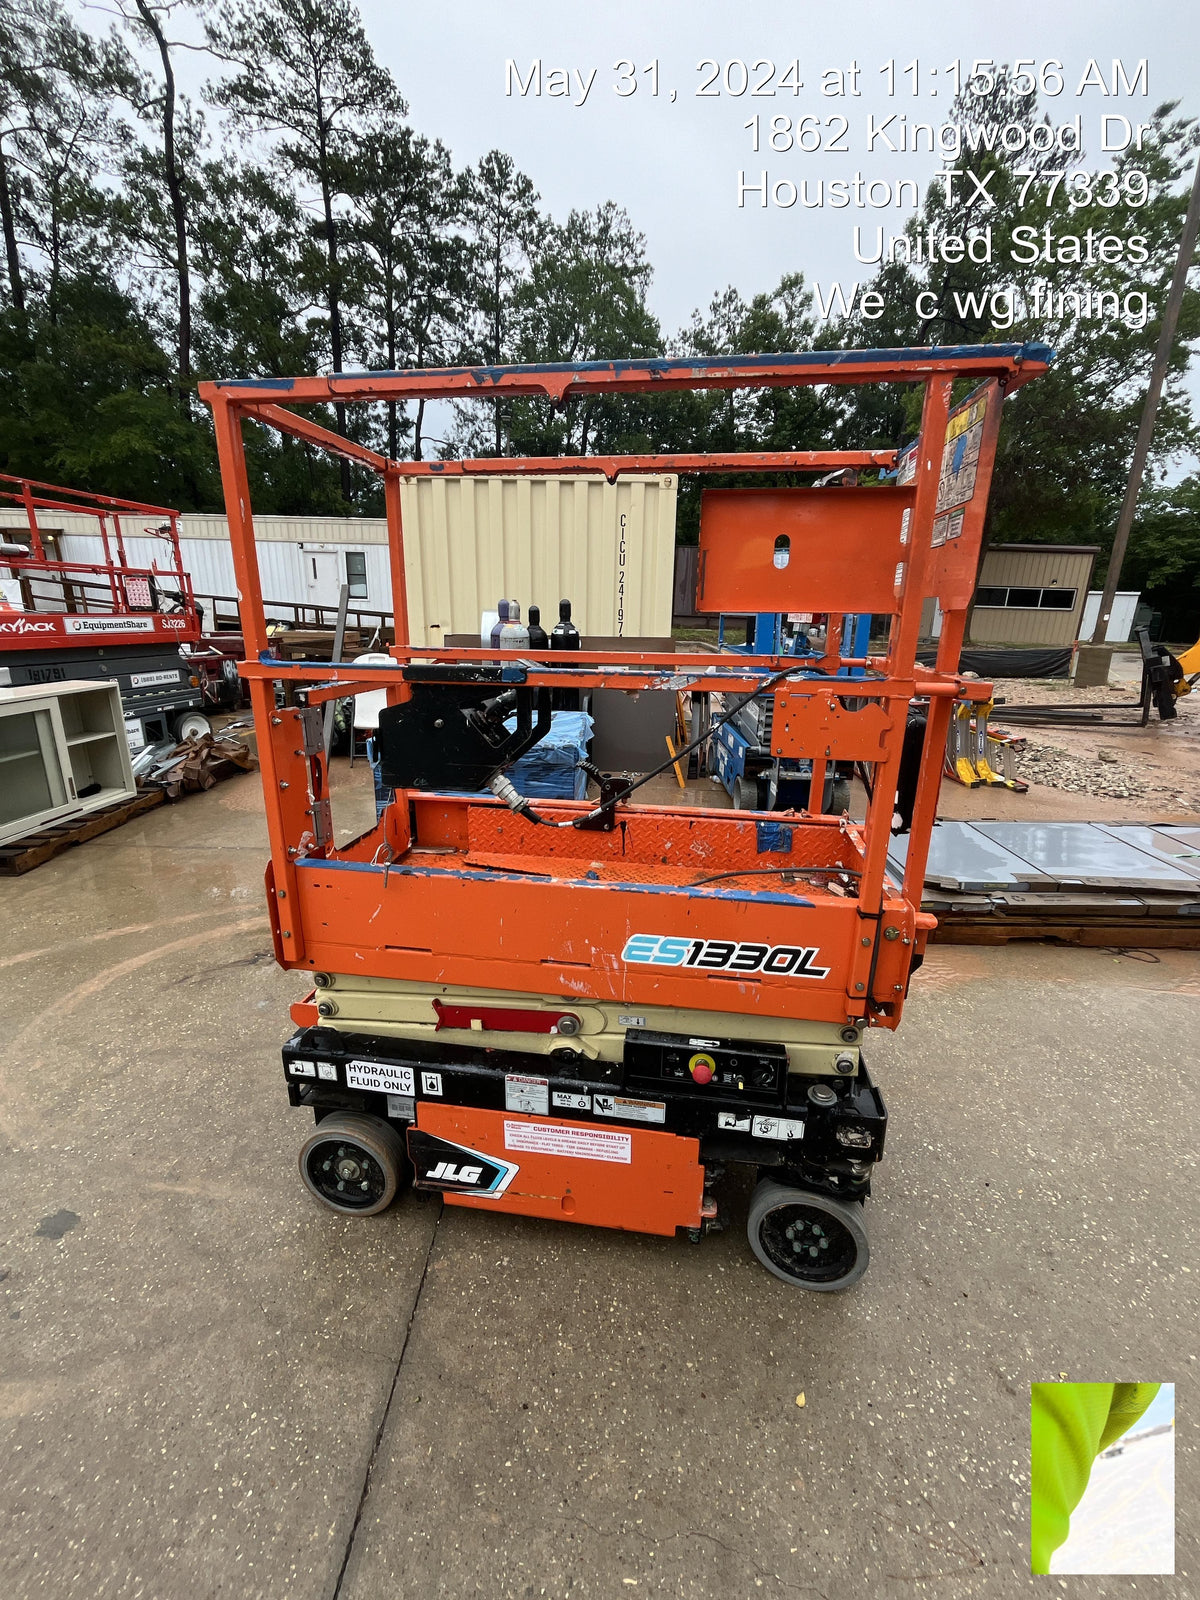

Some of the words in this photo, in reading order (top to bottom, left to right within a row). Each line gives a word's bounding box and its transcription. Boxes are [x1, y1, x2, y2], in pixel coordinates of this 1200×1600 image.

[619, 514, 627, 567] CICU
[0, 617, 57, 634] KYJACK
[82, 620, 148, 631] EquipmentShare
[621, 934, 831, 980] ES1330L
[348, 1064, 411, 1080] HYDRAULIC
[350, 1076, 380, 1088] FLUID
[383, 1080, 411, 1092] ONLY
[533, 1126, 570, 1135] CUSTOMER
[571, 1130, 630, 1142] RESPONSIBILITY
[425, 1162, 484, 1184] JLG
